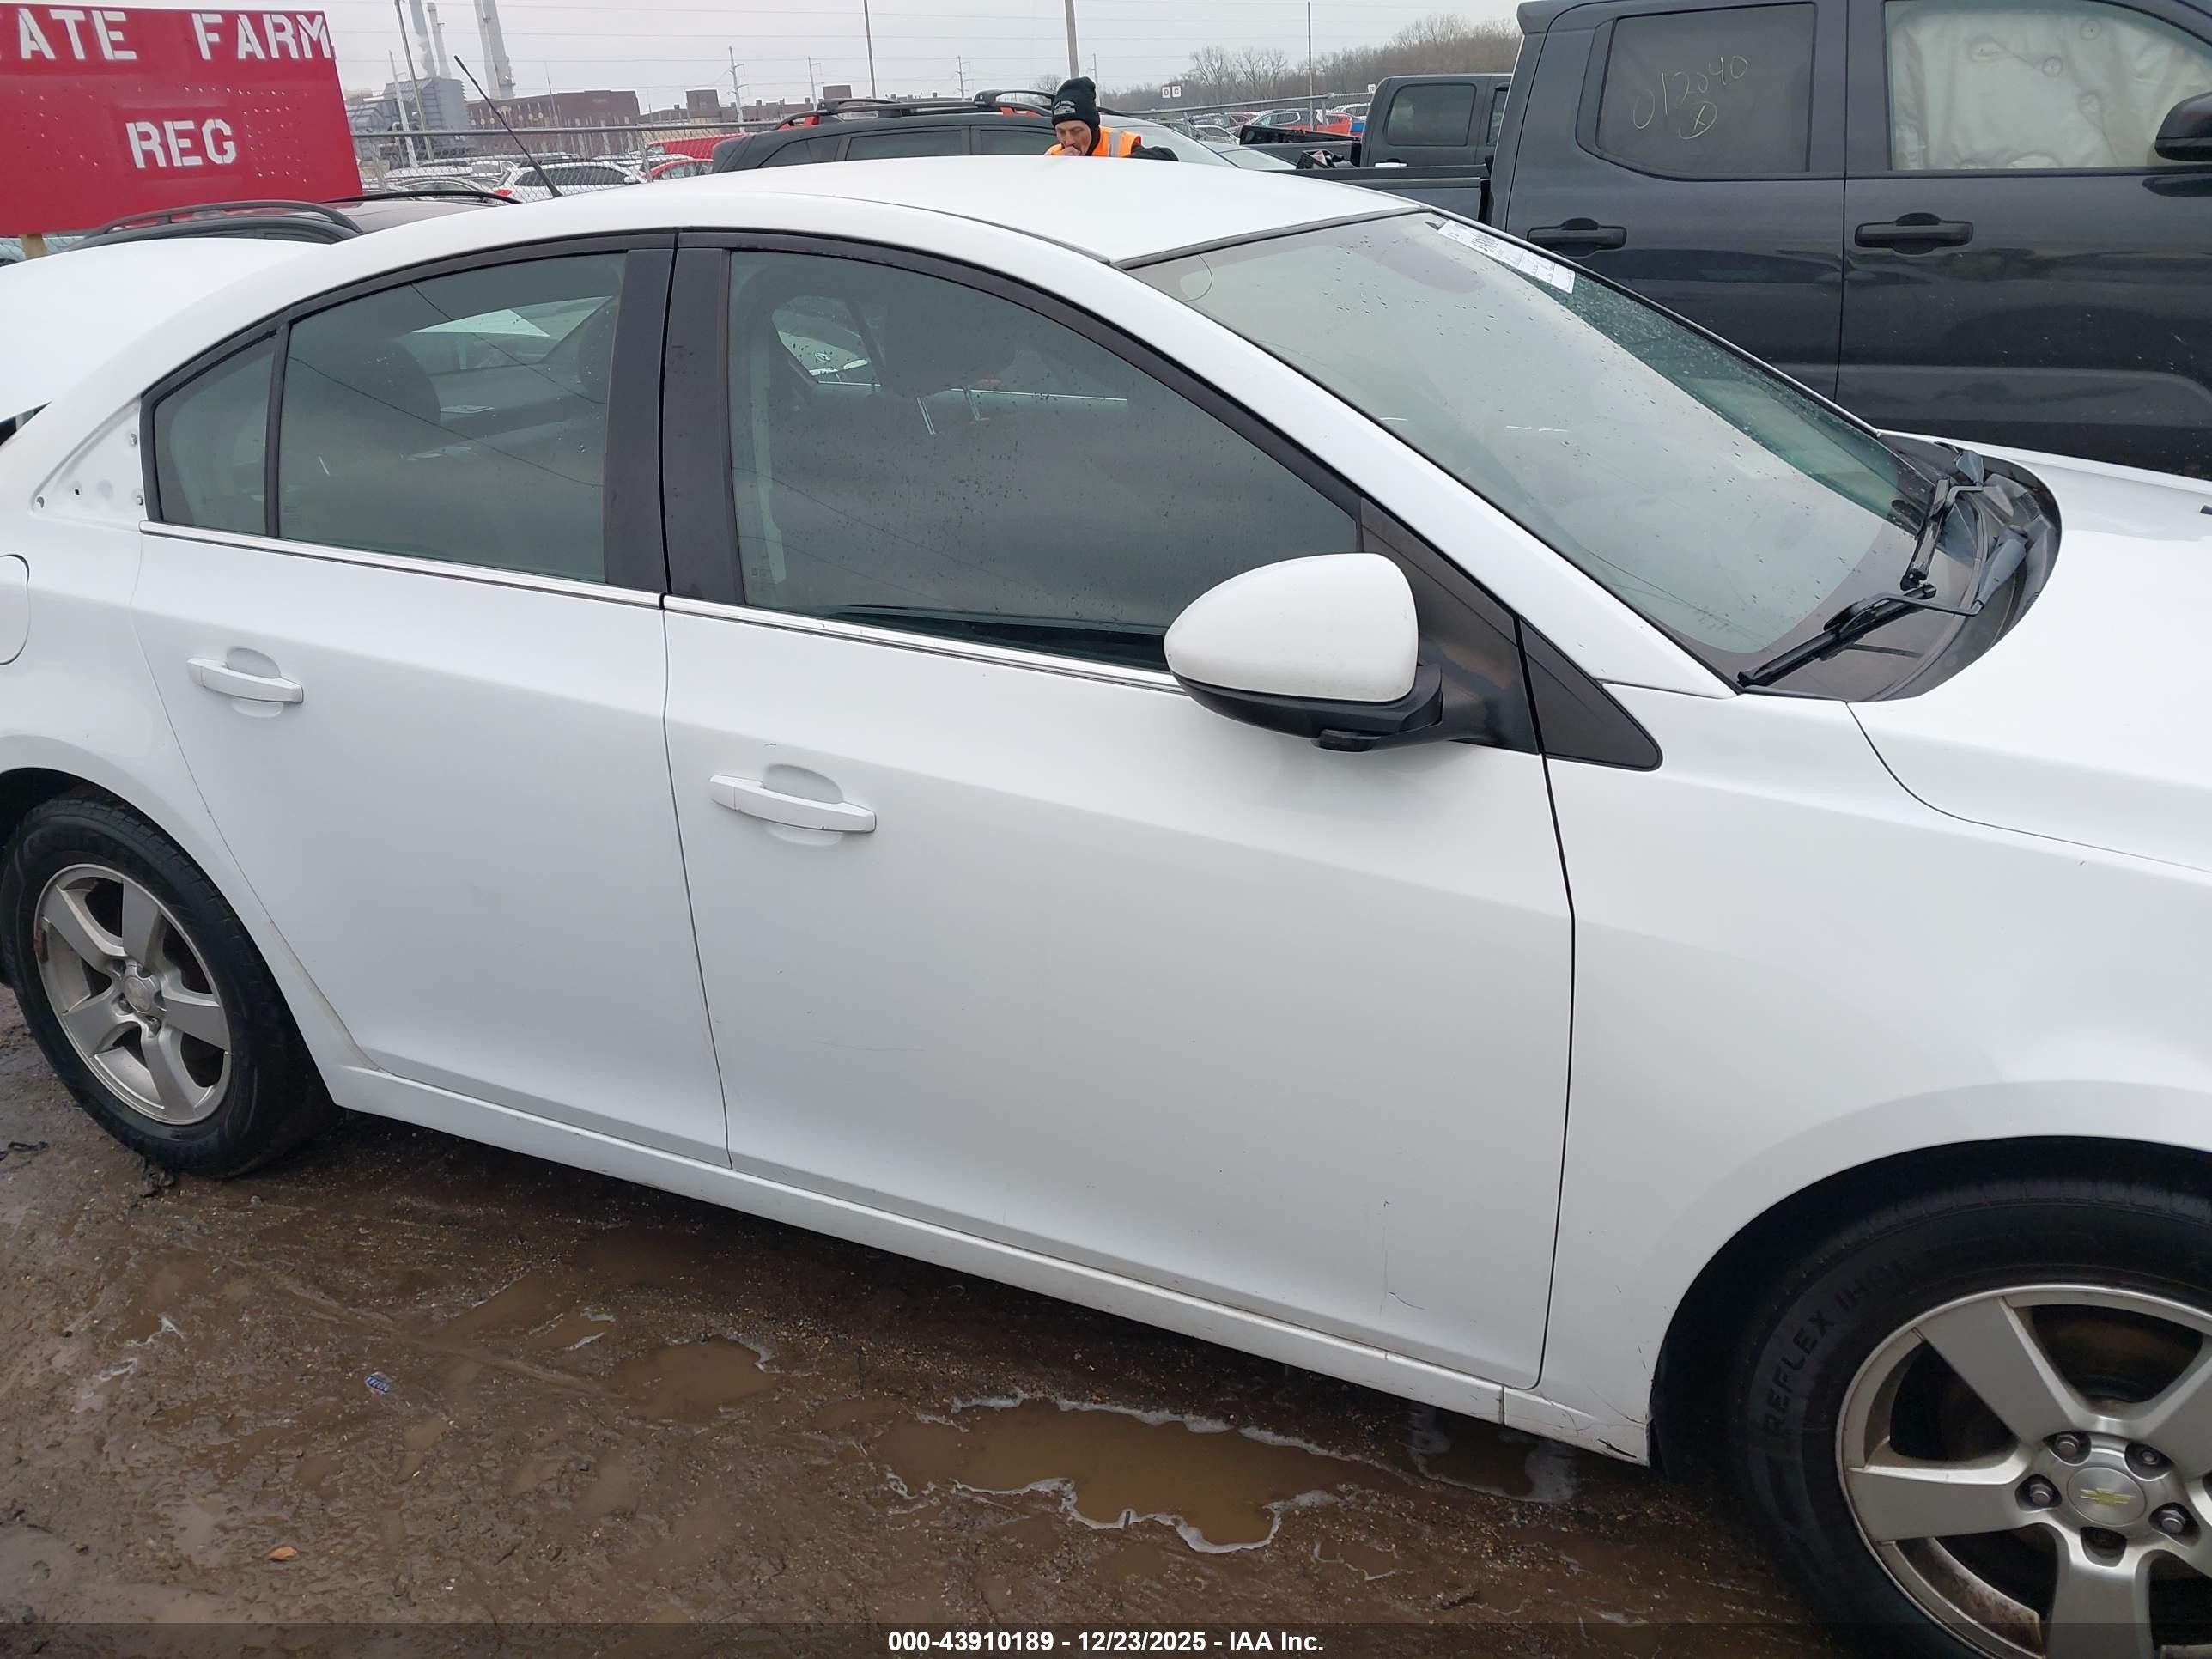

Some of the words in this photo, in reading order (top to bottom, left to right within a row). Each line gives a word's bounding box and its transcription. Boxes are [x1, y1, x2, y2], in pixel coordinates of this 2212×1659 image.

[0, 8, 137, 60] ATE
[192, 13, 331, 60] FARM
[125, 118, 237, 169] REG
[1763, 1310, 1834, 1435] REFLEX
